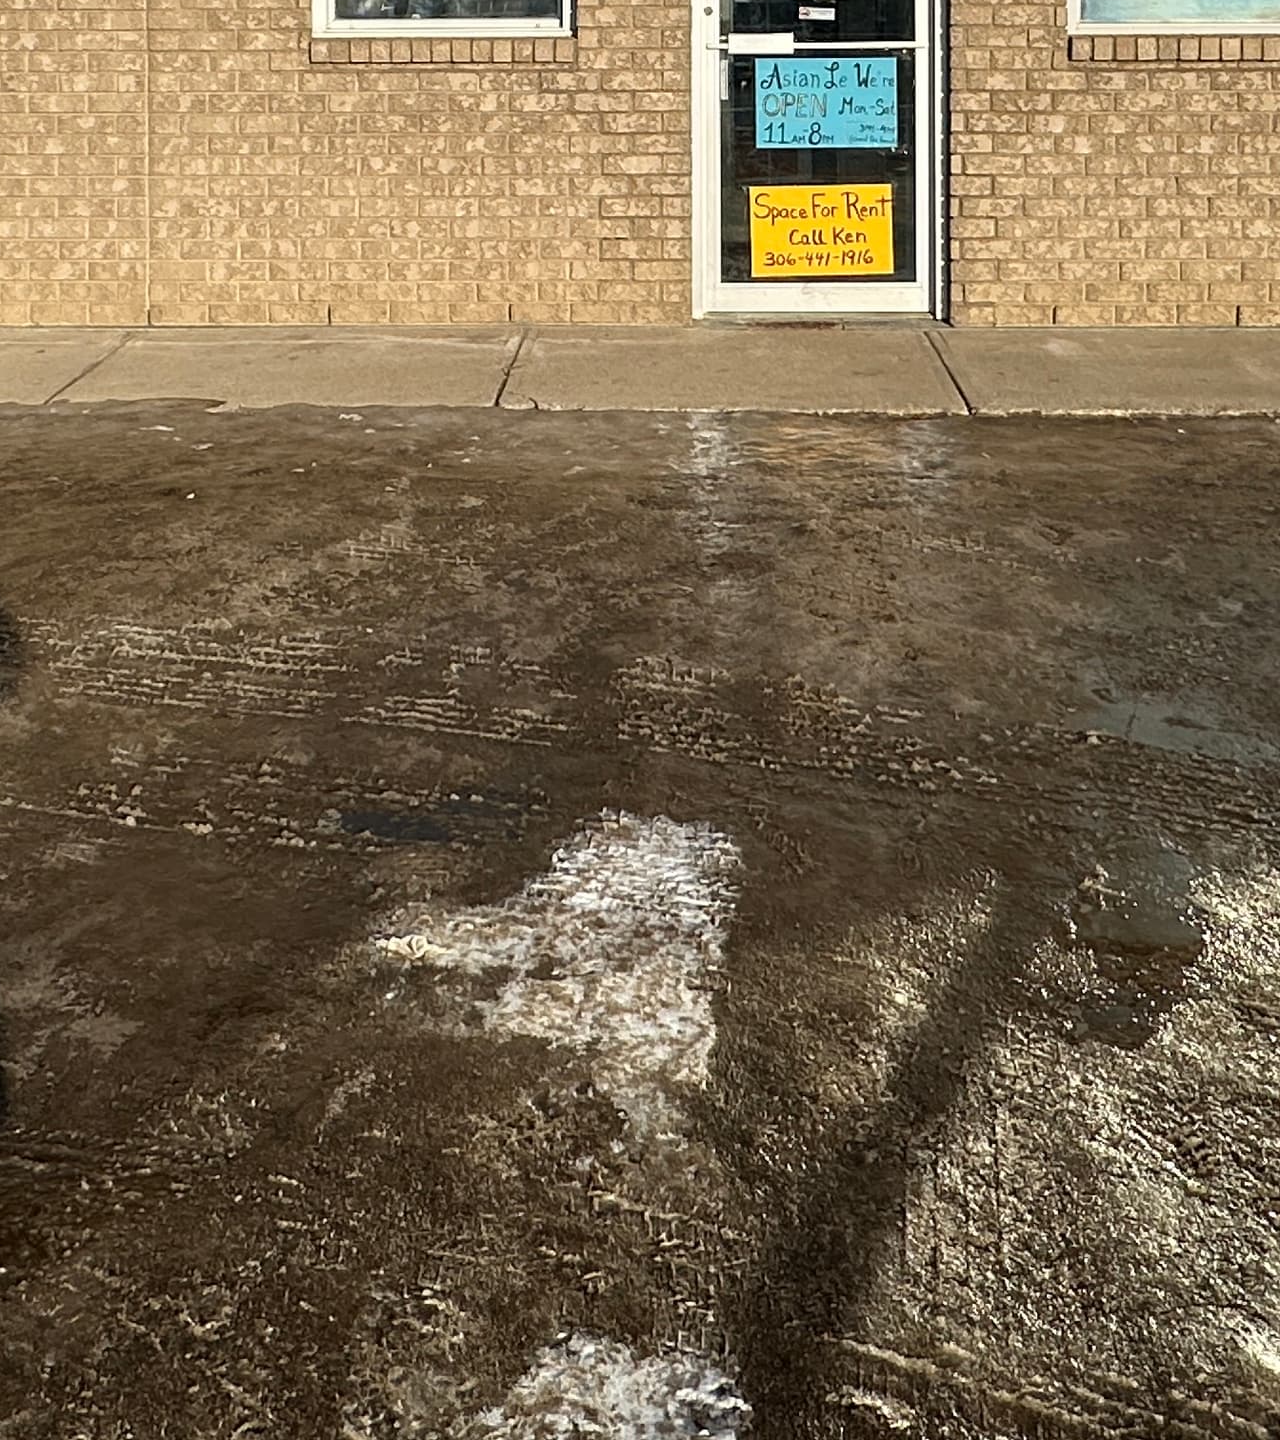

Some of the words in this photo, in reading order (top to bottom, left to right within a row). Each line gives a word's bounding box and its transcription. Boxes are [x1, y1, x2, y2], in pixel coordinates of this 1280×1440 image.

[760, 63, 821, 90] Asian
[824, 61, 848, 89] Le
[853, 62, 895, 88] We're
[762, 92, 827, 118] OPEN
[753, 192, 808, 227] Space
[811, 193, 839, 219] For
[841, 191, 894, 221] Rent
[789, 229, 827, 246] Call
[832, 226, 868, 246] Ken
[763, 249, 874, 267] 306-441-1916
